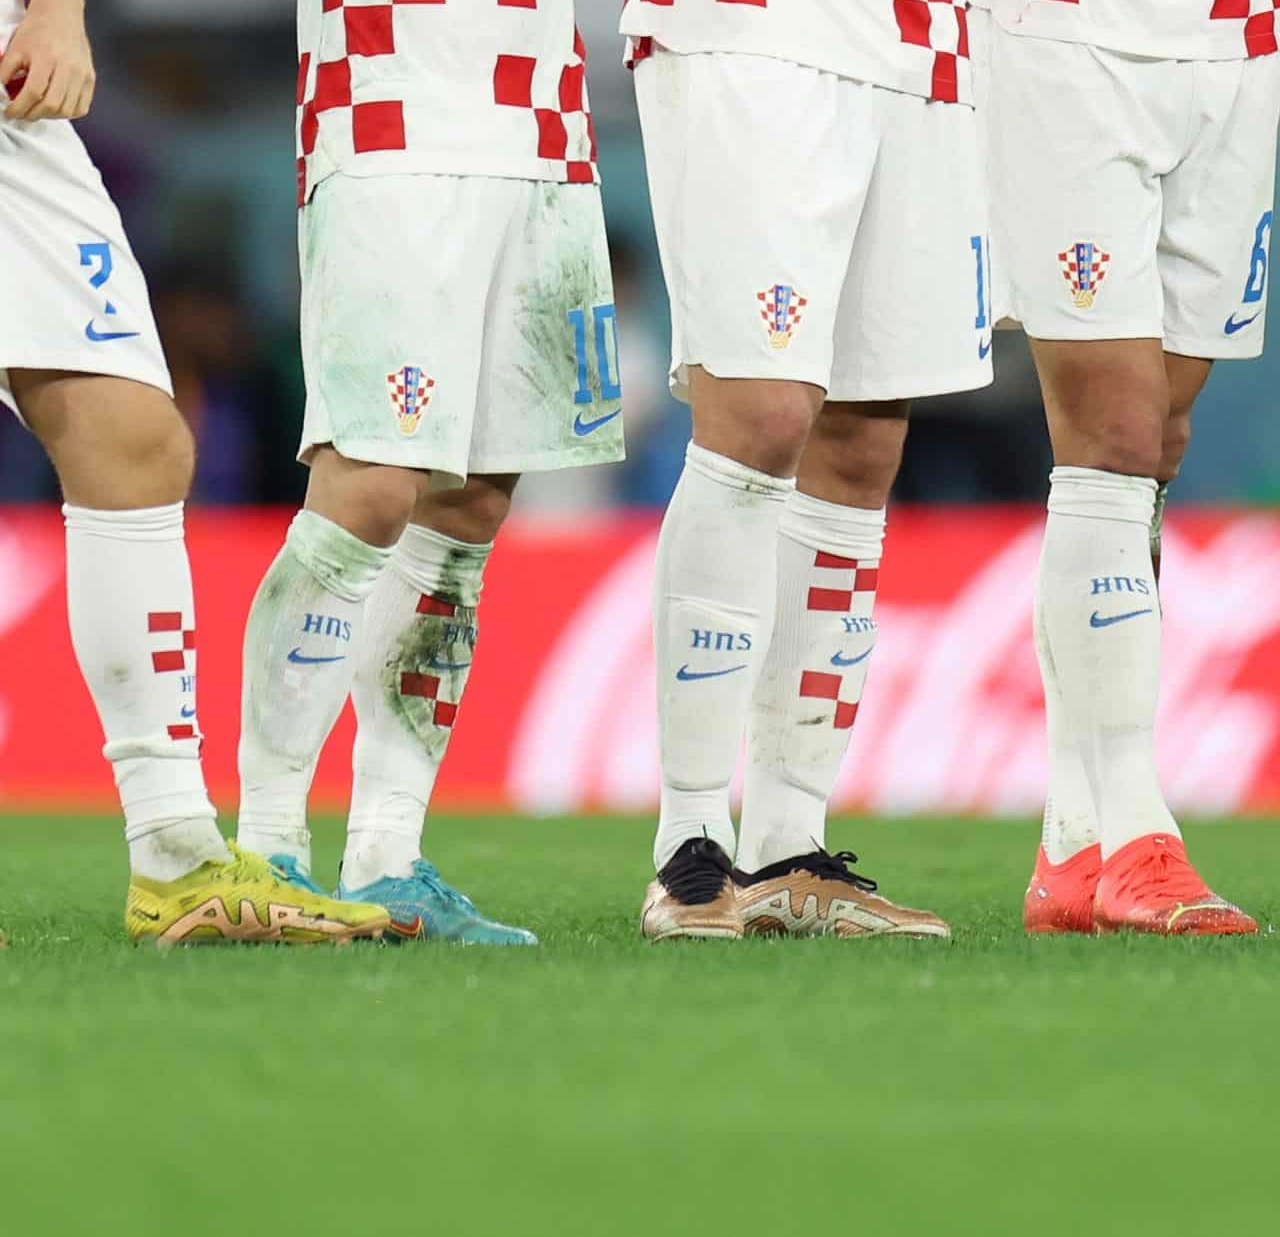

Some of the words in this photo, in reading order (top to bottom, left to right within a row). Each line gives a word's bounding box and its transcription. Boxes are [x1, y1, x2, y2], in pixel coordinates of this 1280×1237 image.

[1242, 210, 1274, 304] 6
[567, 304, 621, 405] 10
[1090, 576, 1150, 596] HNS
[301, 613, 352, 642] HNS
[690, 628, 753, 652] HNS
